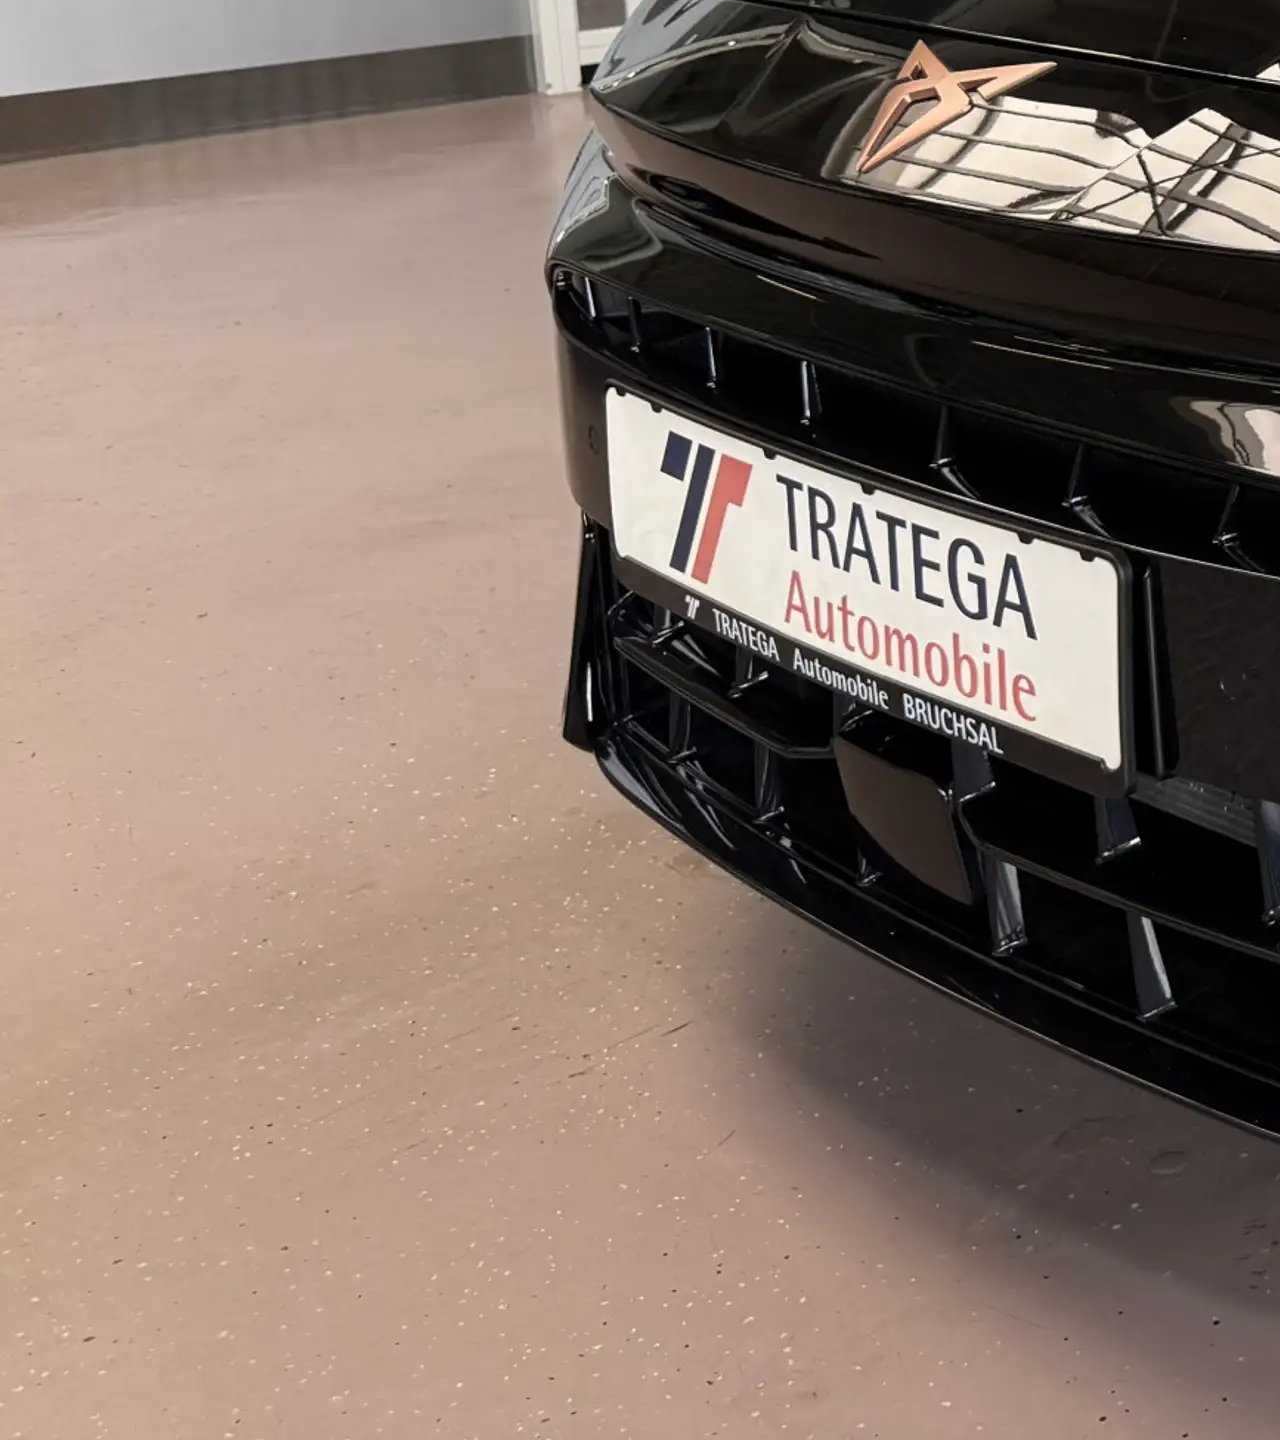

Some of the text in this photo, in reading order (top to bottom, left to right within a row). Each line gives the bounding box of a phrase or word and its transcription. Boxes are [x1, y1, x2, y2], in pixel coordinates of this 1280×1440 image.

[775, 473, 1039, 642] TRATEGA
[712, 608, 1004, 755] TRATEGA Automobile BRUCHSAL
[783, 569, 1038, 723] Automobile
